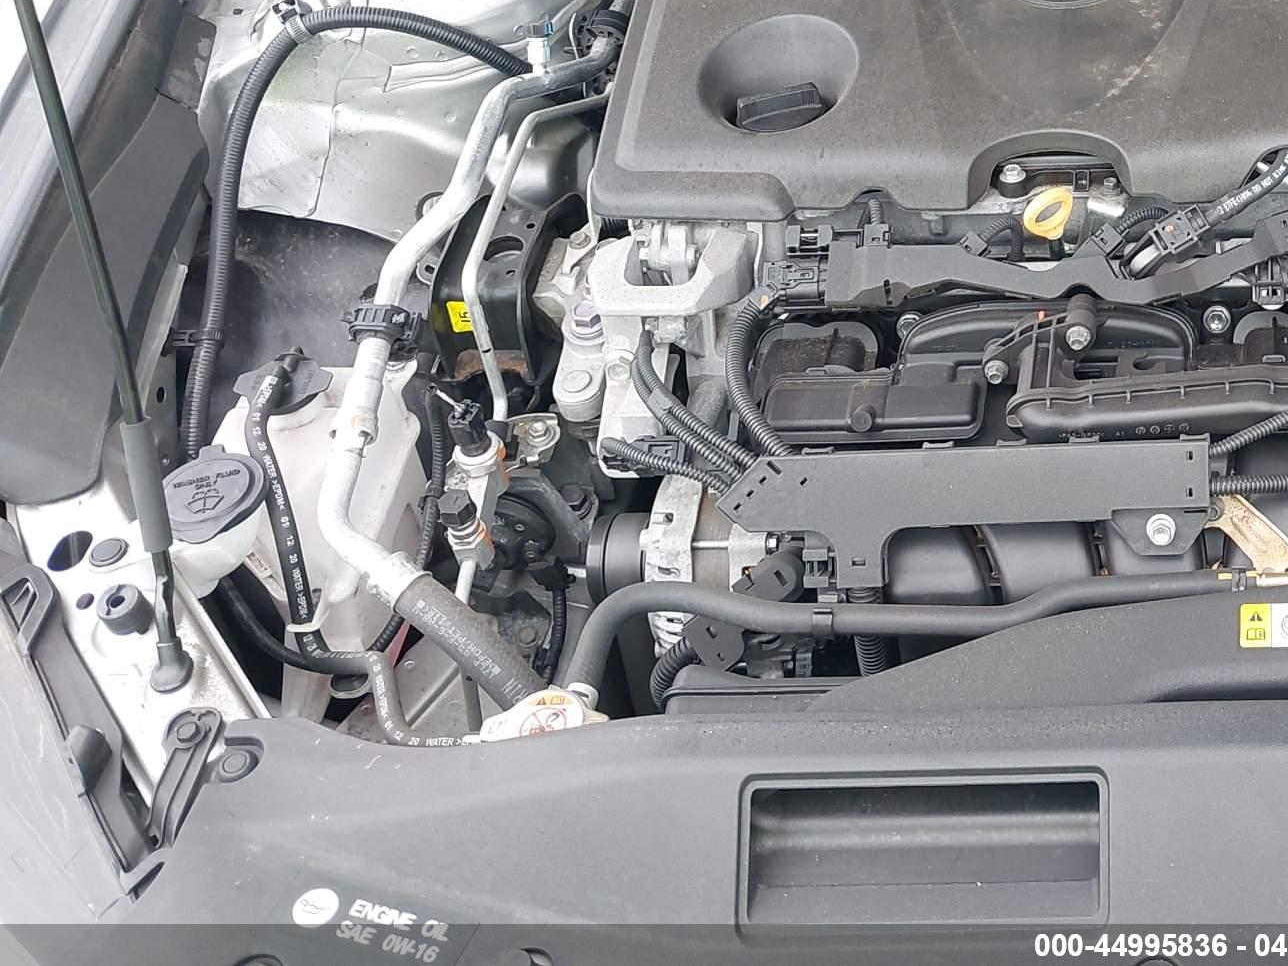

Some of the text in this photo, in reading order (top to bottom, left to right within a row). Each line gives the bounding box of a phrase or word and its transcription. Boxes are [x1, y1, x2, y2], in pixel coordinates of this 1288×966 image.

[262, 454, 277, 479] WATER
[292, 567, 303, 593] WATER
[407, 736, 421, 746] 20
[425, 737, 454, 747] WATER
[348, 899, 449, 941] ENGINE OIL
[336, 920, 440, 963] SAE 0W-16
